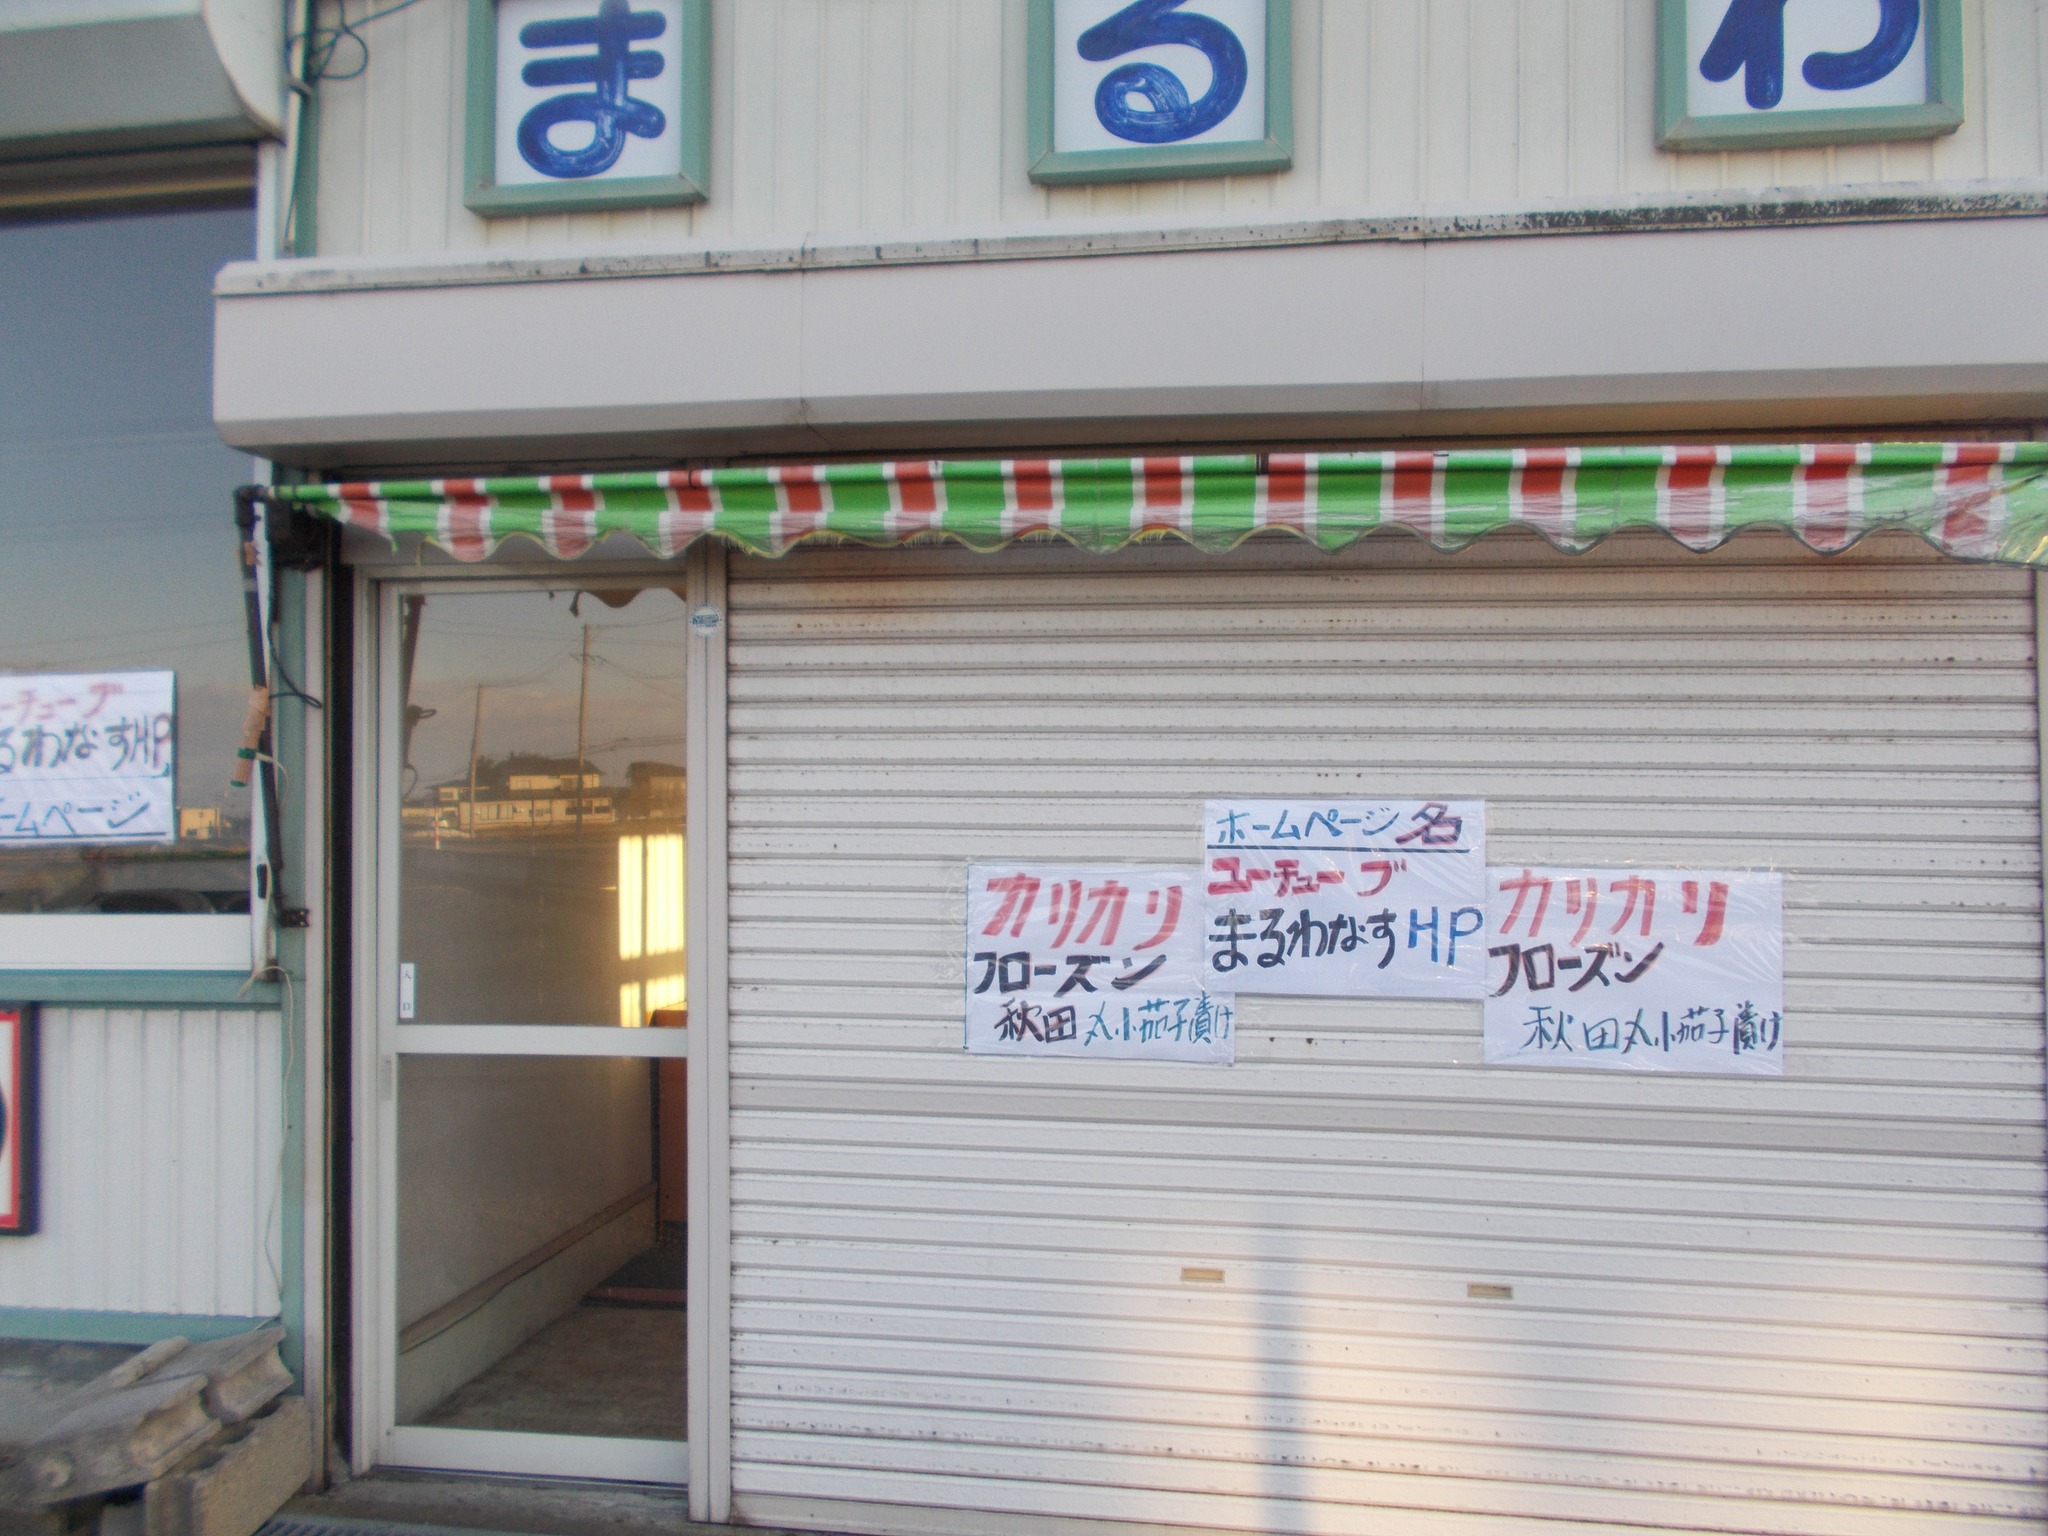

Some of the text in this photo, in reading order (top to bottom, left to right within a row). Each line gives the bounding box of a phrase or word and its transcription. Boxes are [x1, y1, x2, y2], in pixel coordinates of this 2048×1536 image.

[517, 0, 667, 178] ま
[1077, 0, 1247, 143] る
[1216, 802, 1463, 845] ホームページ名
[1207, 857, 1407, 897] ユーチューブ
[982, 872, 1183, 950] カリカリ
[1500, 868, 1729, 947] カリカリ
[973, 951, 1167, 998] フローズン
[1488, 942, 1664, 997] フローズン
